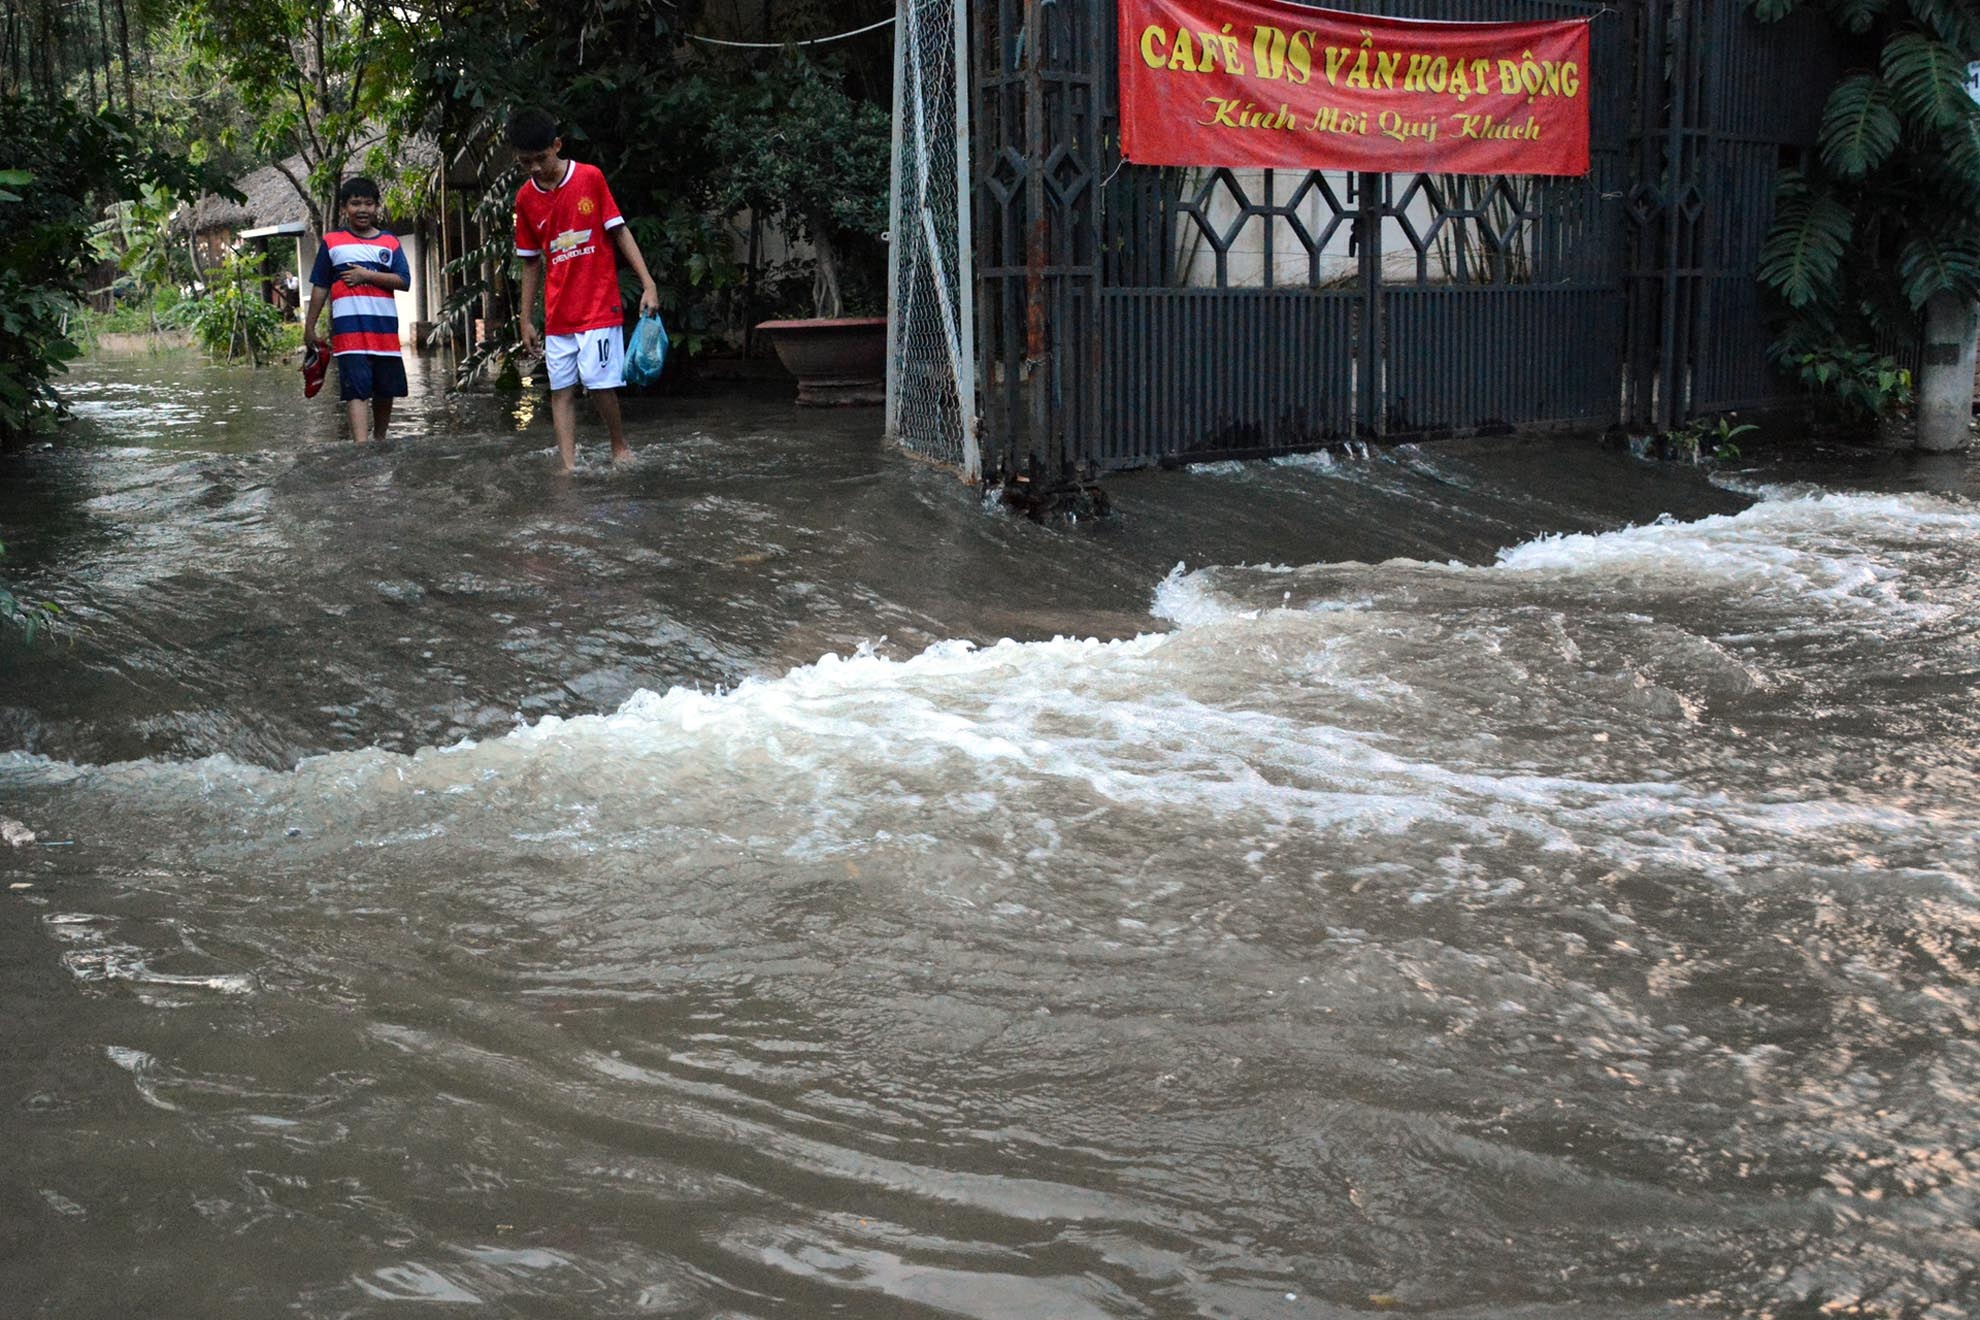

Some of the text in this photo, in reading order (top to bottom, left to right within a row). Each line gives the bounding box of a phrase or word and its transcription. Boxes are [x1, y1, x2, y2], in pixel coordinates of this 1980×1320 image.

[1140, 23, 1580, 104] CAFÉ DS VẪN HOẠT ĐỘNG
[1197, 97, 1541, 143] Kính Mời Quý Khách
[597, 338, 610, 362] 10
